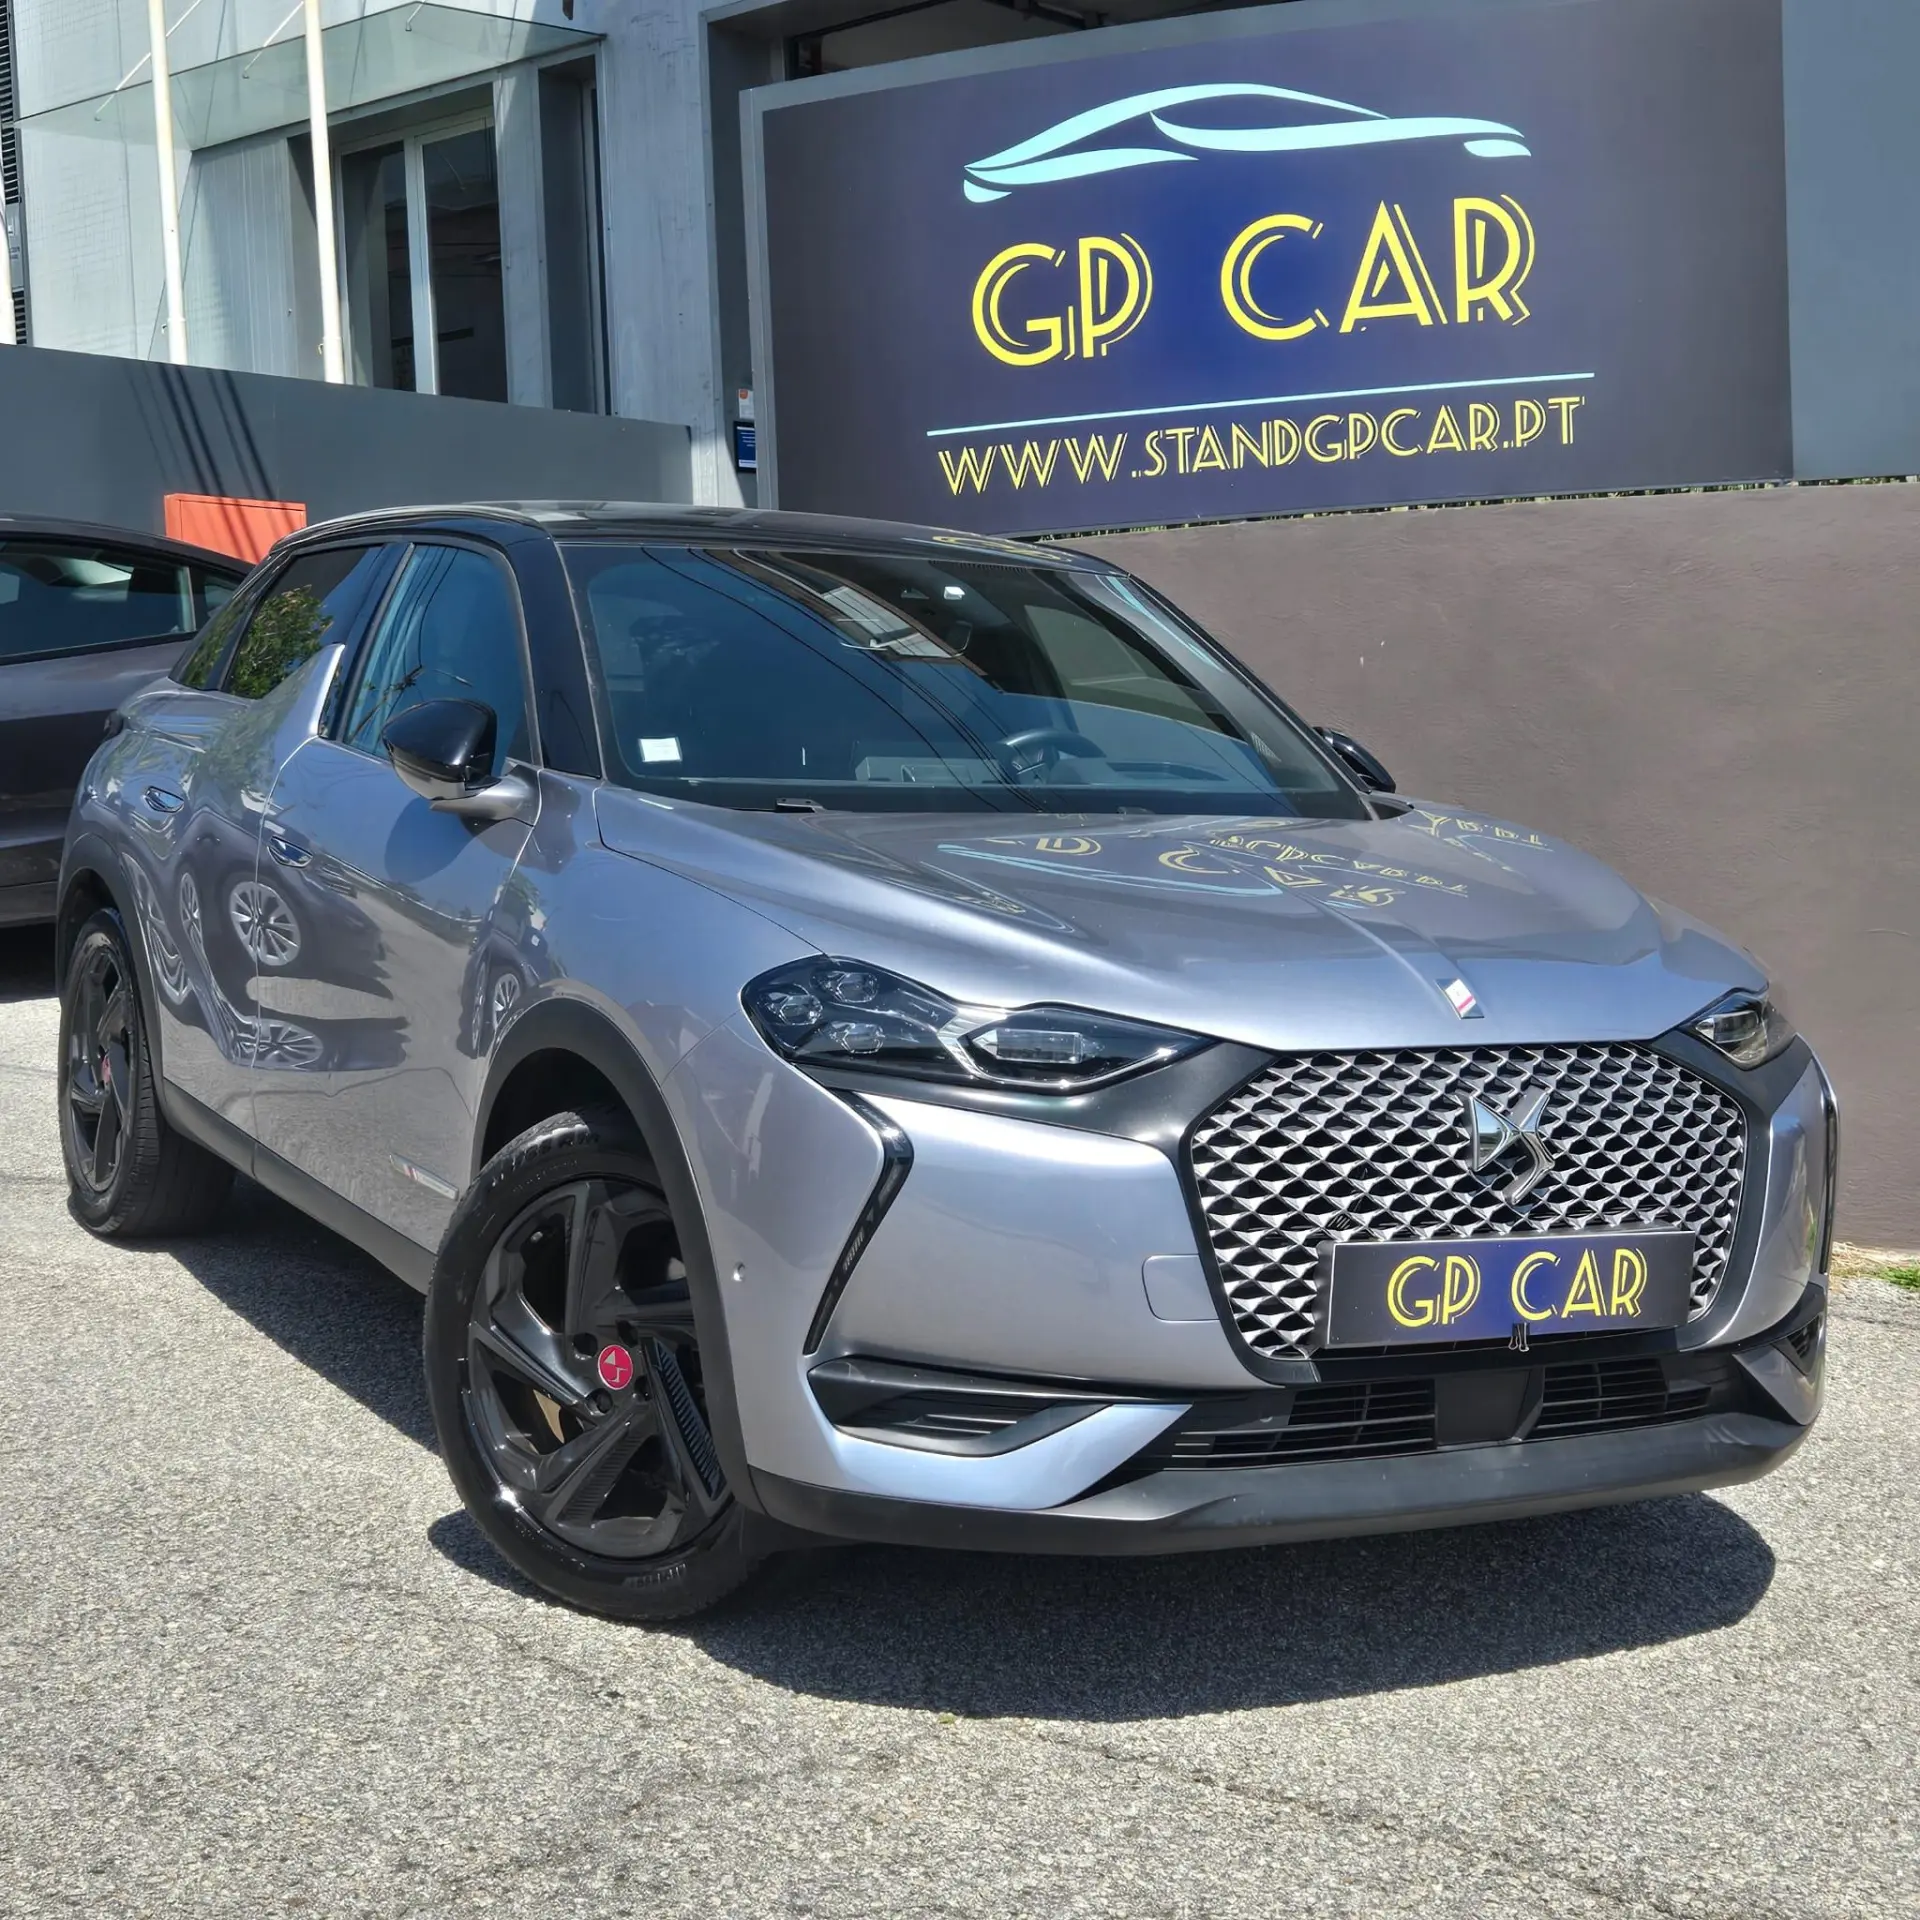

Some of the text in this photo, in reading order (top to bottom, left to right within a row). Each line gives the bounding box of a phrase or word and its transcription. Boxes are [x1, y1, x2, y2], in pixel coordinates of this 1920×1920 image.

[972, 195, 1536, 367] GP CAR
[938, 396, 1586, 496] WWW.STANDGPCAR.PT
[1386, 1247, 1648, 1328] GP CAR
